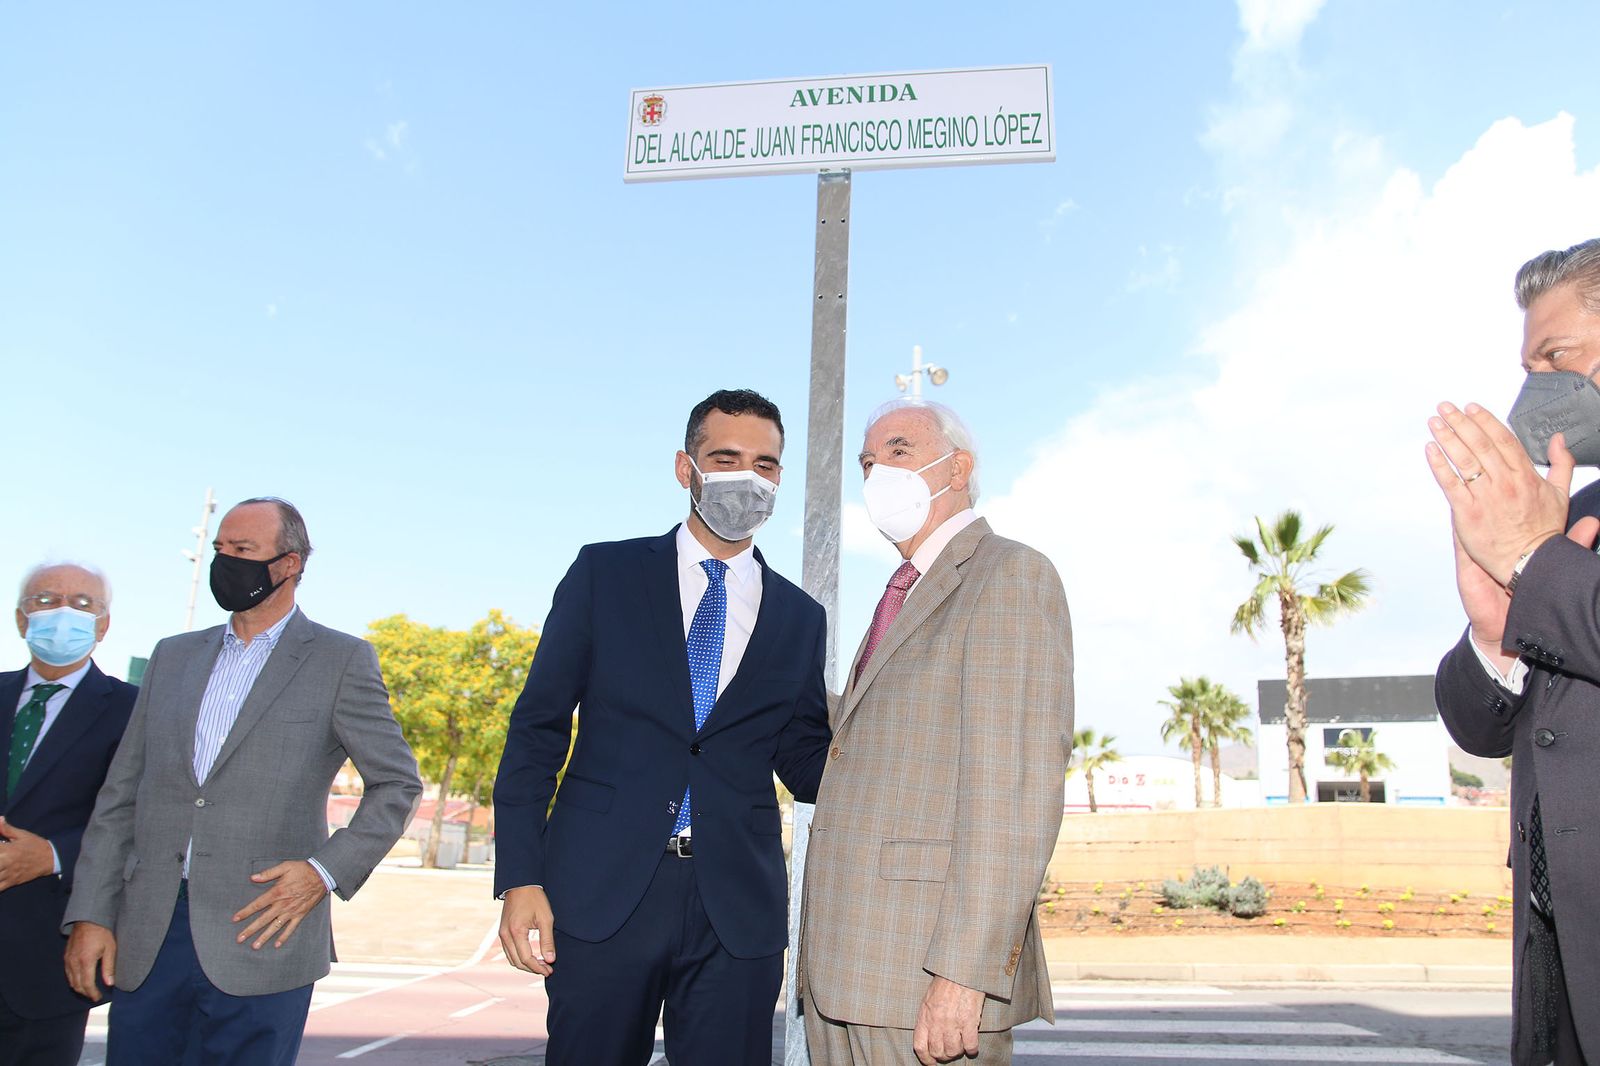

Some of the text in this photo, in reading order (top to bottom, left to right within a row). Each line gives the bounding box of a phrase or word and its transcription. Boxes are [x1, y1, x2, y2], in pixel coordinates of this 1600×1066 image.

[789, 83, 918, 108] AVENIDA
[634, 105, 1043, 165] DEL ALCALDE JUAN FRANCISCO MEGINO LÓPEZ
